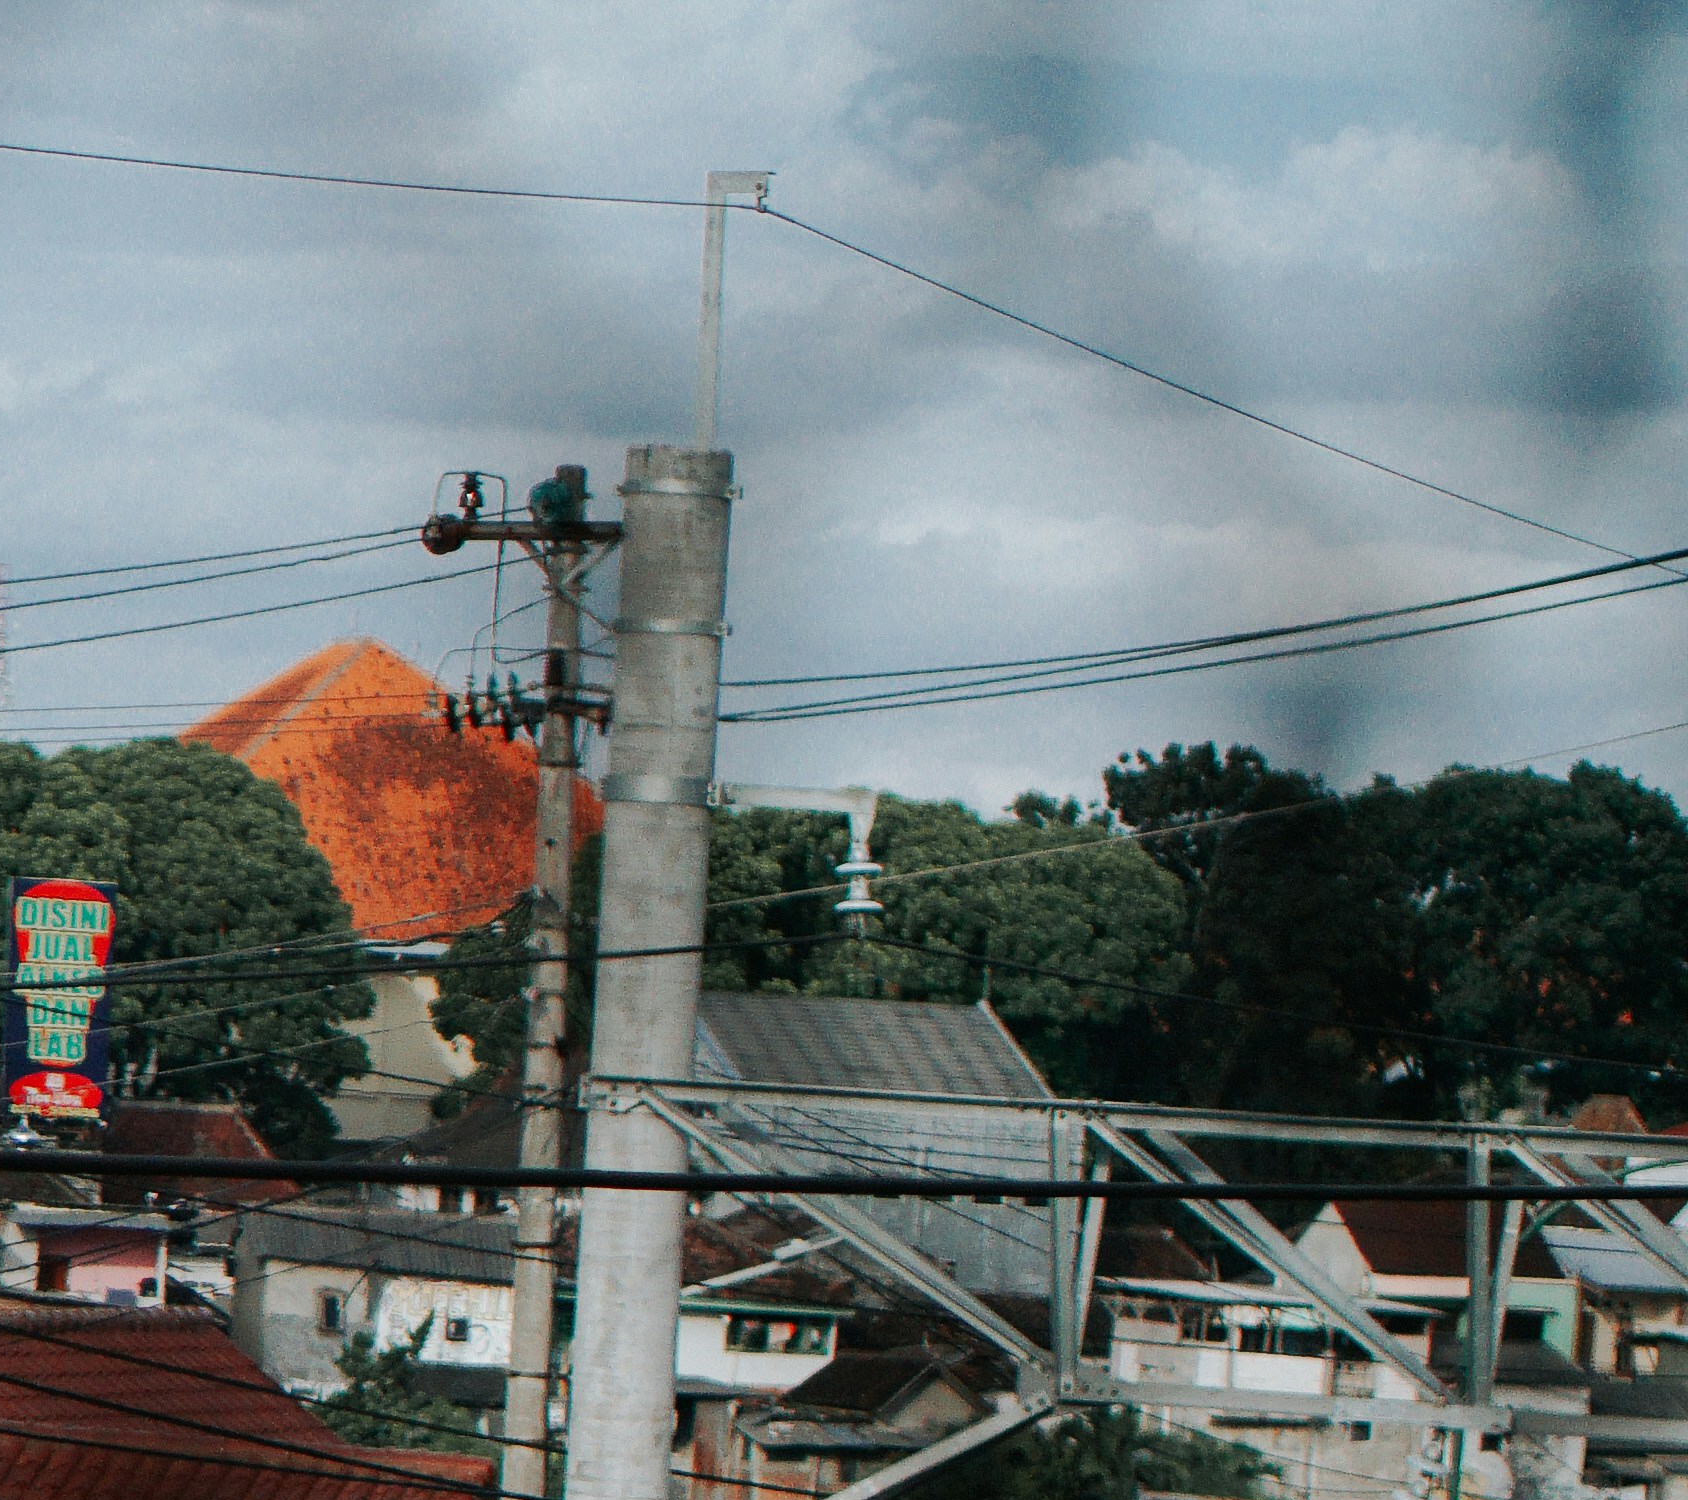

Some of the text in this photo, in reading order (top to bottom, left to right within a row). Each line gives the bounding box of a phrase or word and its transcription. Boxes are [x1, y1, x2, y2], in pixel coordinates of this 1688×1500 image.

[21, 900, 109, 931] DISINI
[32, 932, 93, 961] JUAL
[32, 997, 88, 1026] DAN
[33, 1031, 83, 1060] LAB
